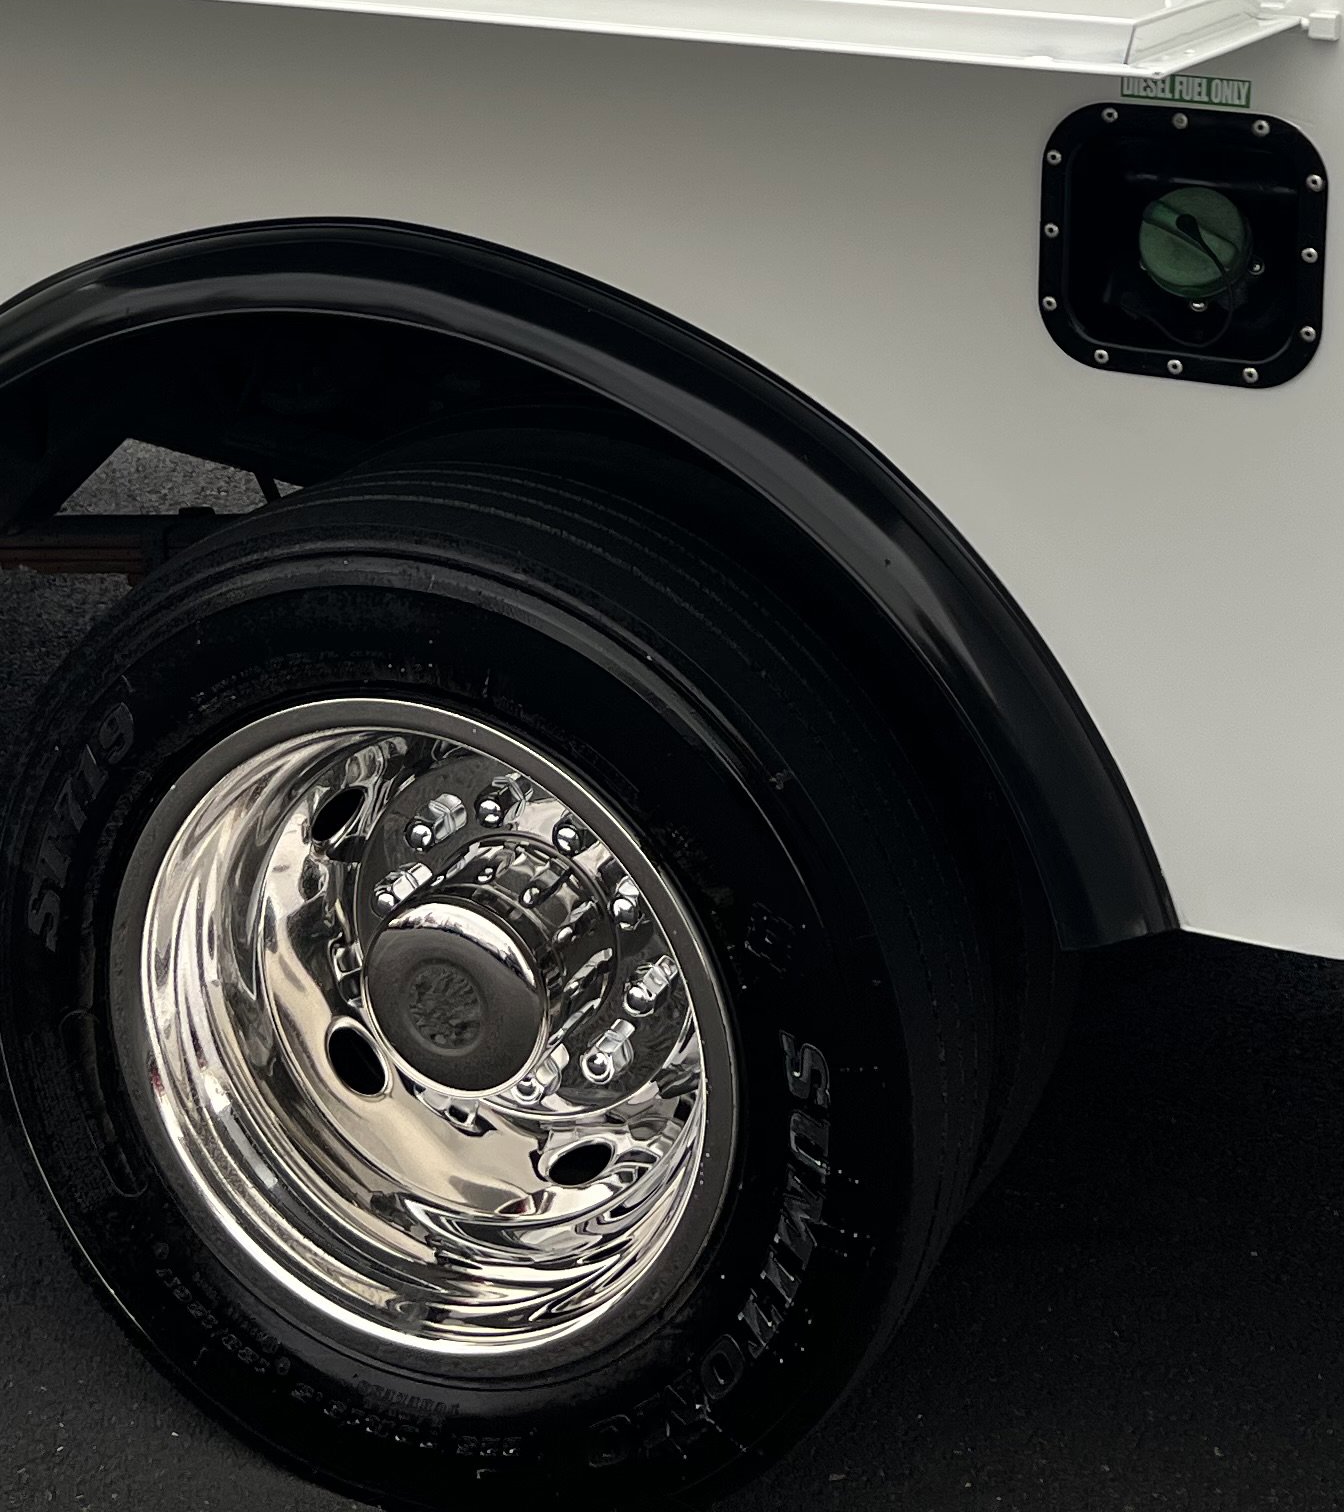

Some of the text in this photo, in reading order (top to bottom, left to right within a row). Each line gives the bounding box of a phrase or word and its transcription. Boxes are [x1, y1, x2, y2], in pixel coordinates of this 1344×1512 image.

[1123, 75, 1250, 105] DIESEL FUEL ONLY
